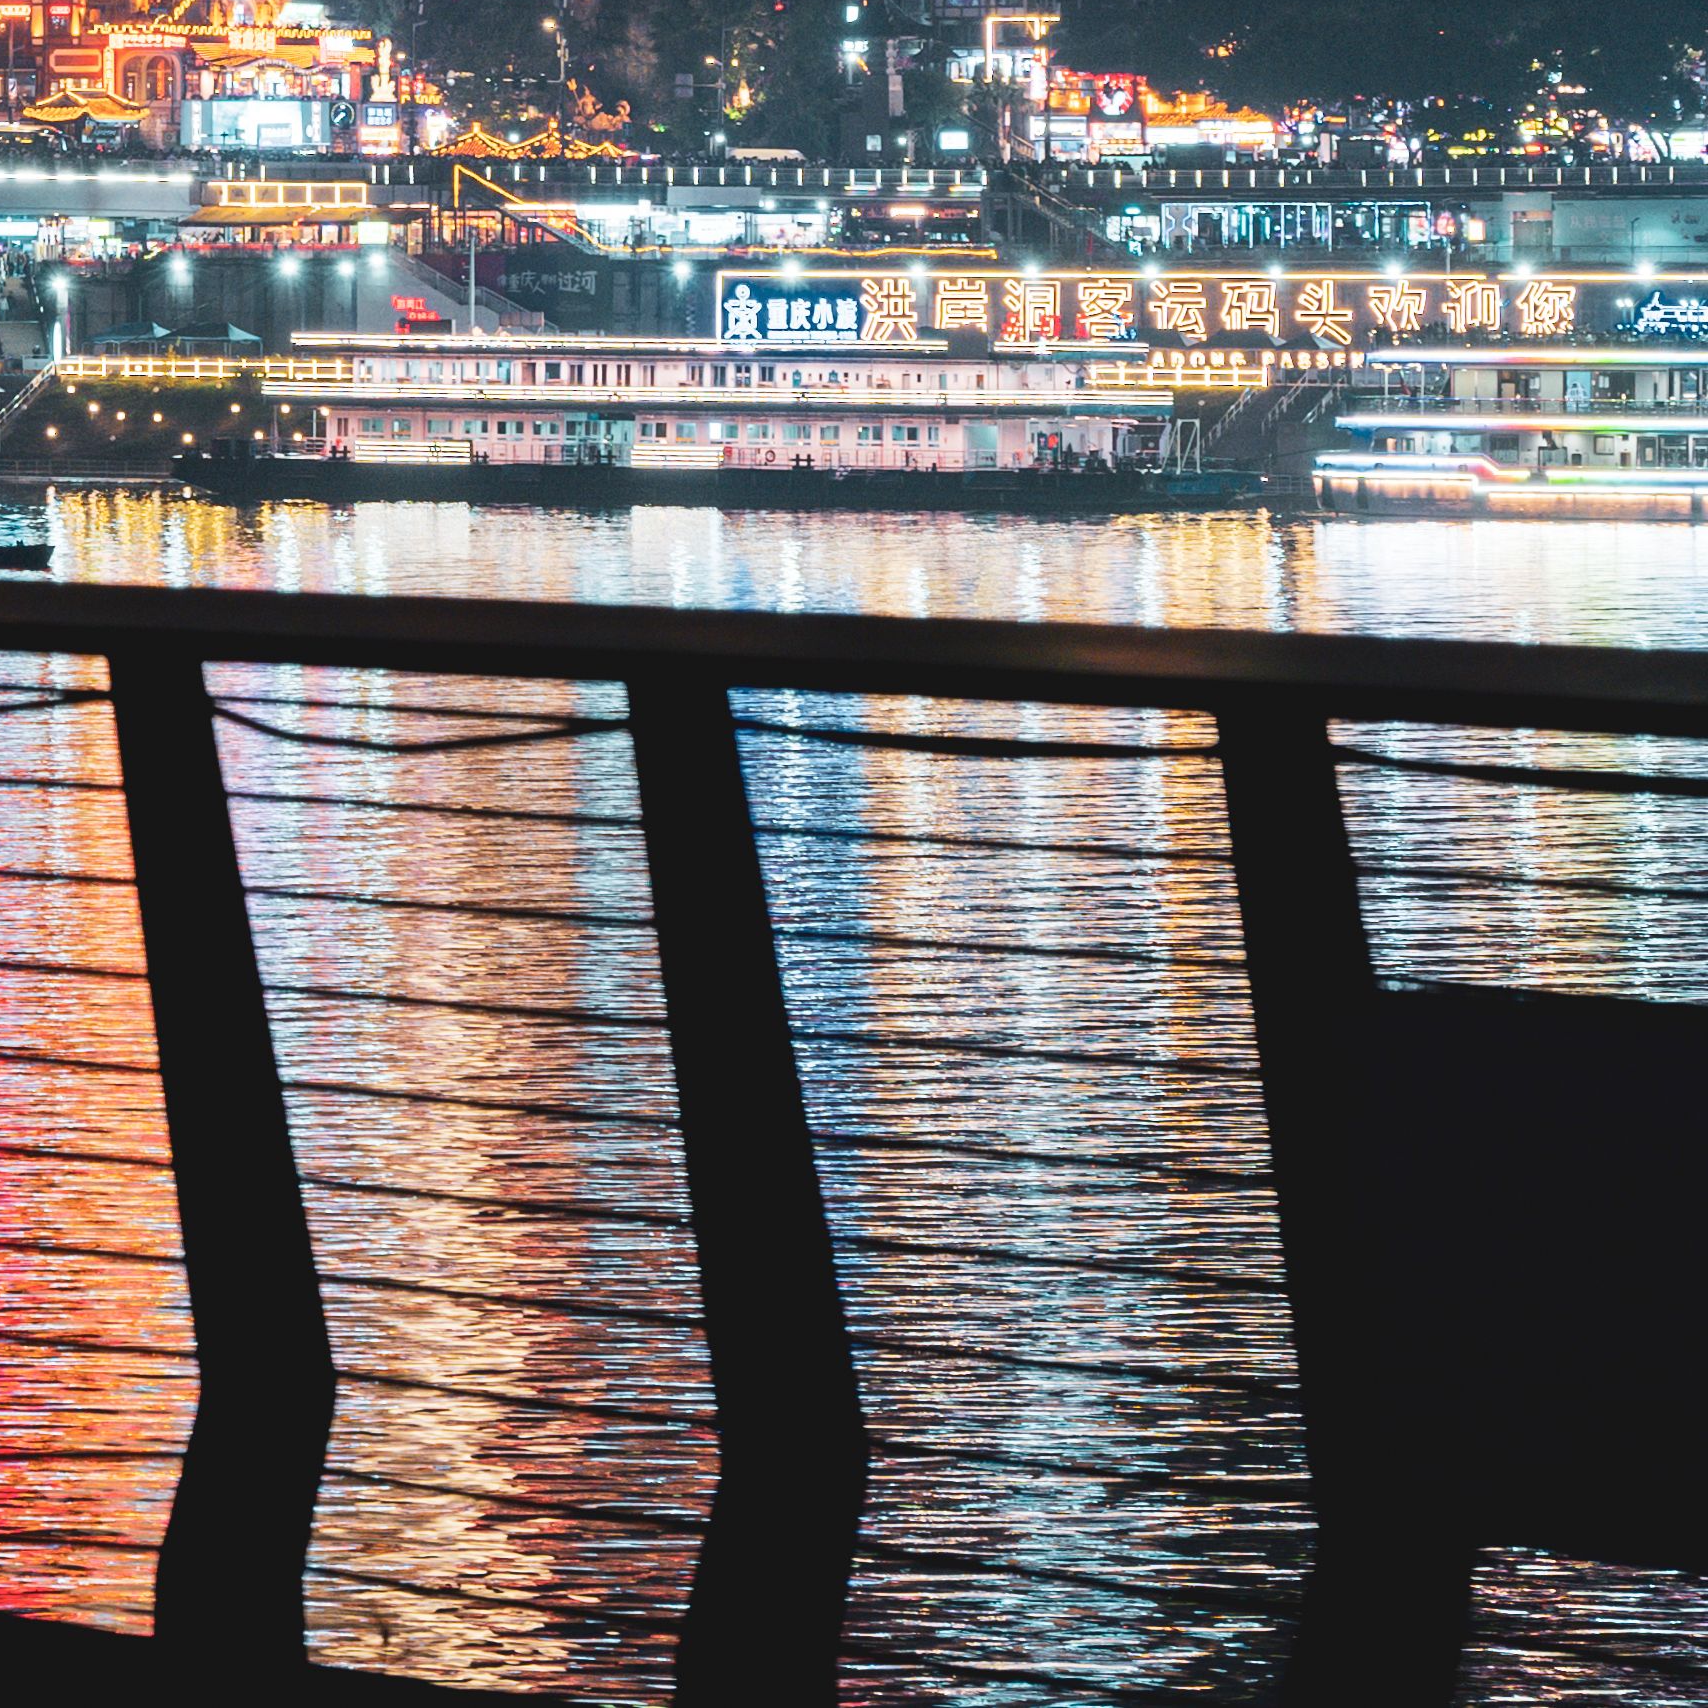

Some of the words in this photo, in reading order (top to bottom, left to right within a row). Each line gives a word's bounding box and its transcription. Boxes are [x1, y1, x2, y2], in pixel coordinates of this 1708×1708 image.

[767, 298, 858, 330] 重庆小渡
[859, 278, 1577, 344] 洪崖洞客运码头欢迎您
